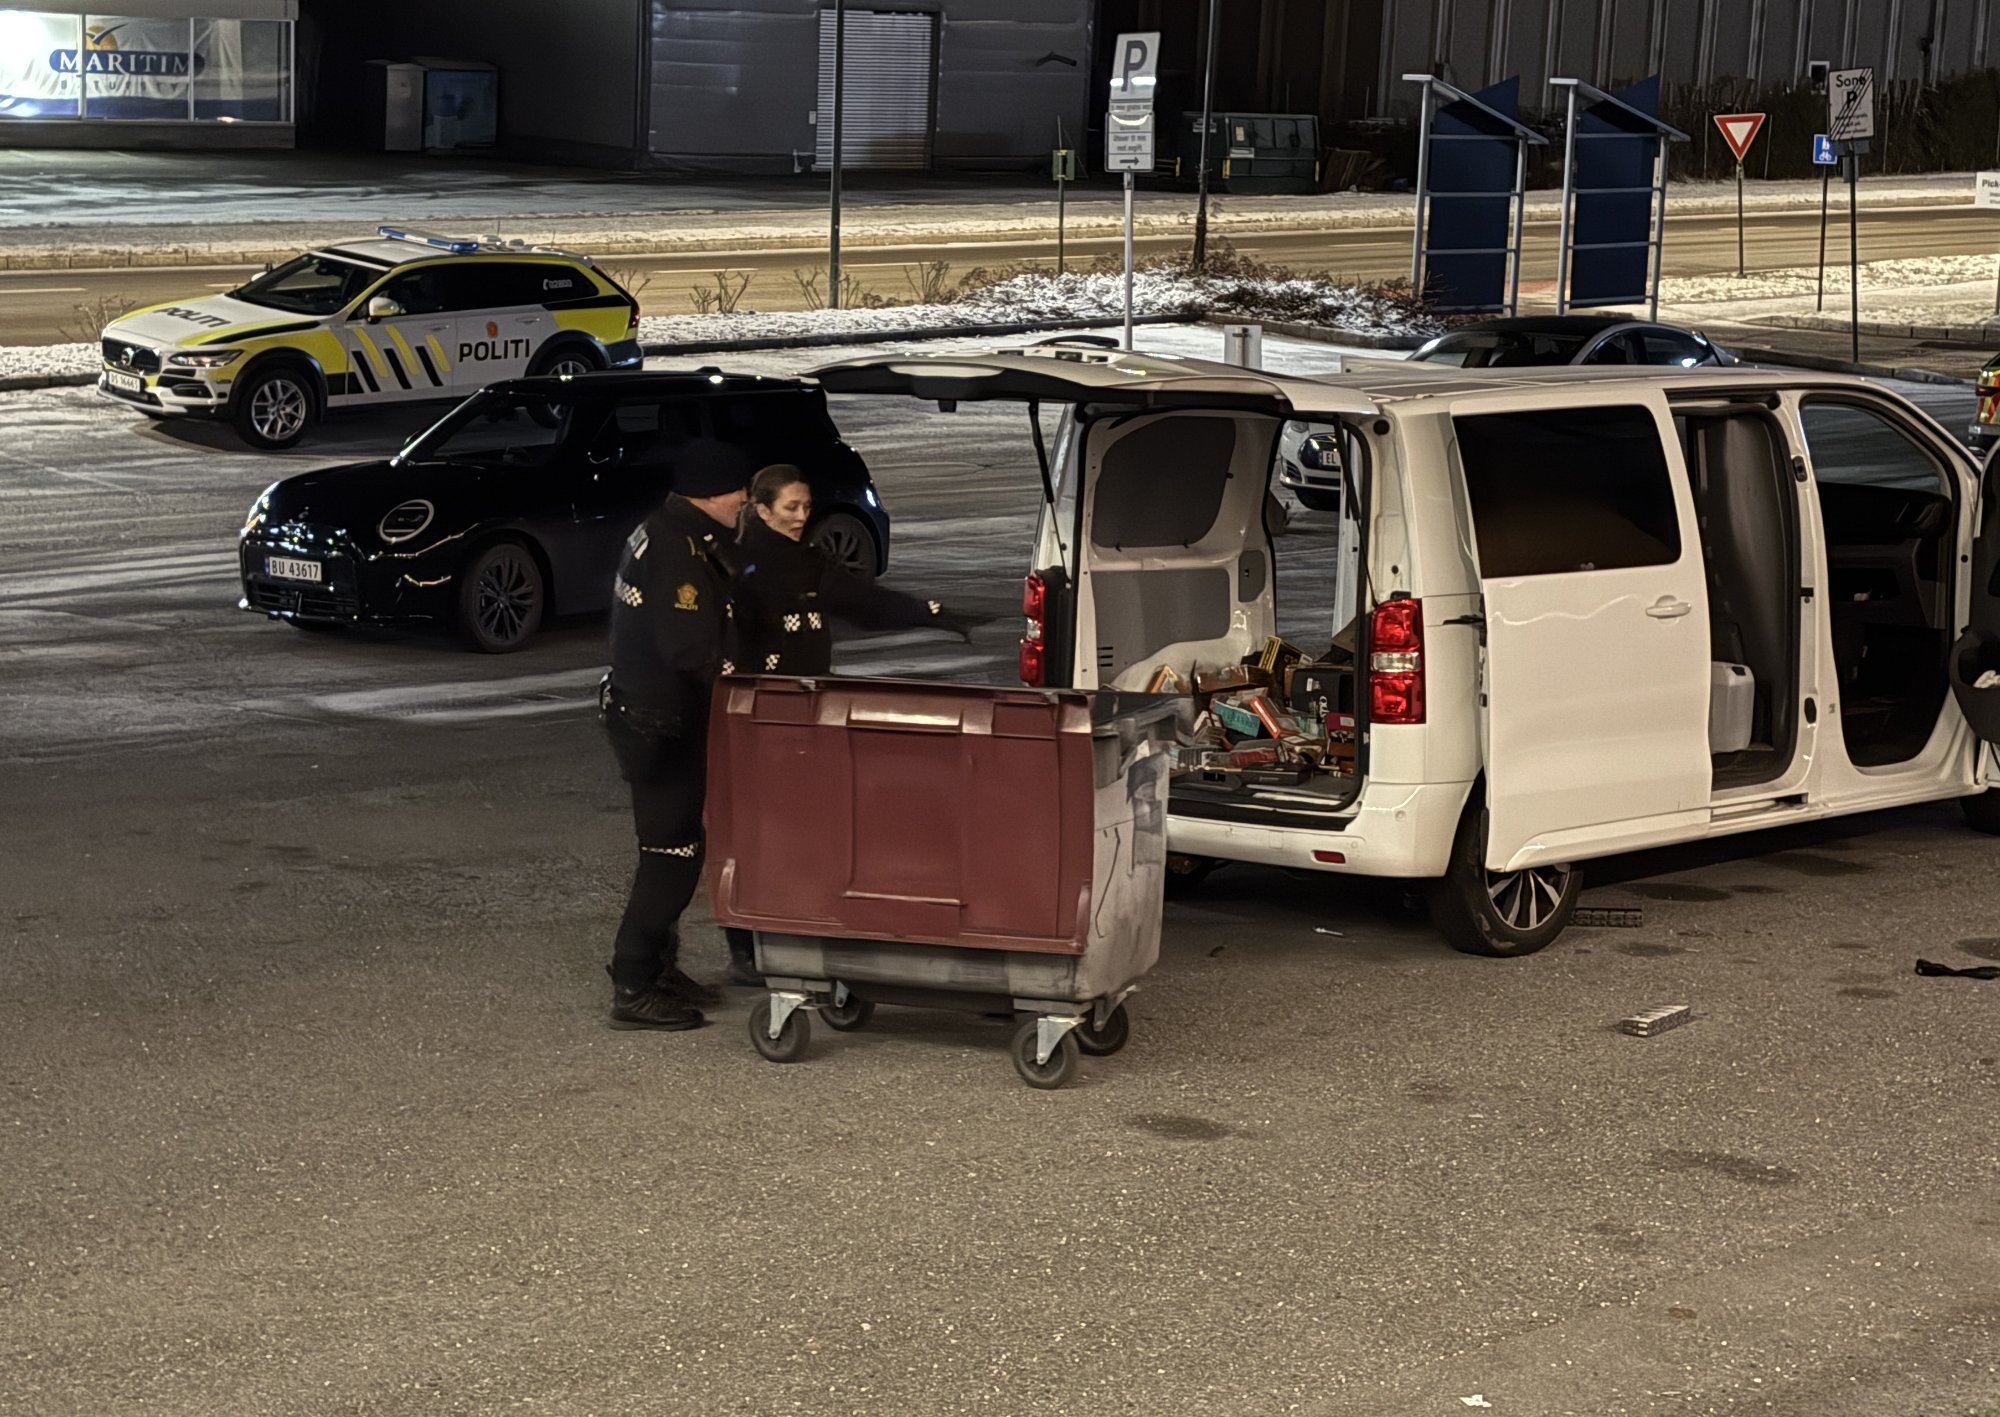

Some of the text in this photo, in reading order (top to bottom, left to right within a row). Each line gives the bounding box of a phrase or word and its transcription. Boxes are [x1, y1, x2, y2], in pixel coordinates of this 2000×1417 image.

[60, 52, 190, 75] MARITIM
[1121, 40, 1147, 92] P
[152, 306, 231, 328] POLITI
[458, 338, 530, 362] POLITI
[1326, 452, 1337, 465] EL
[272, 560, 319, 579] BU 43617
